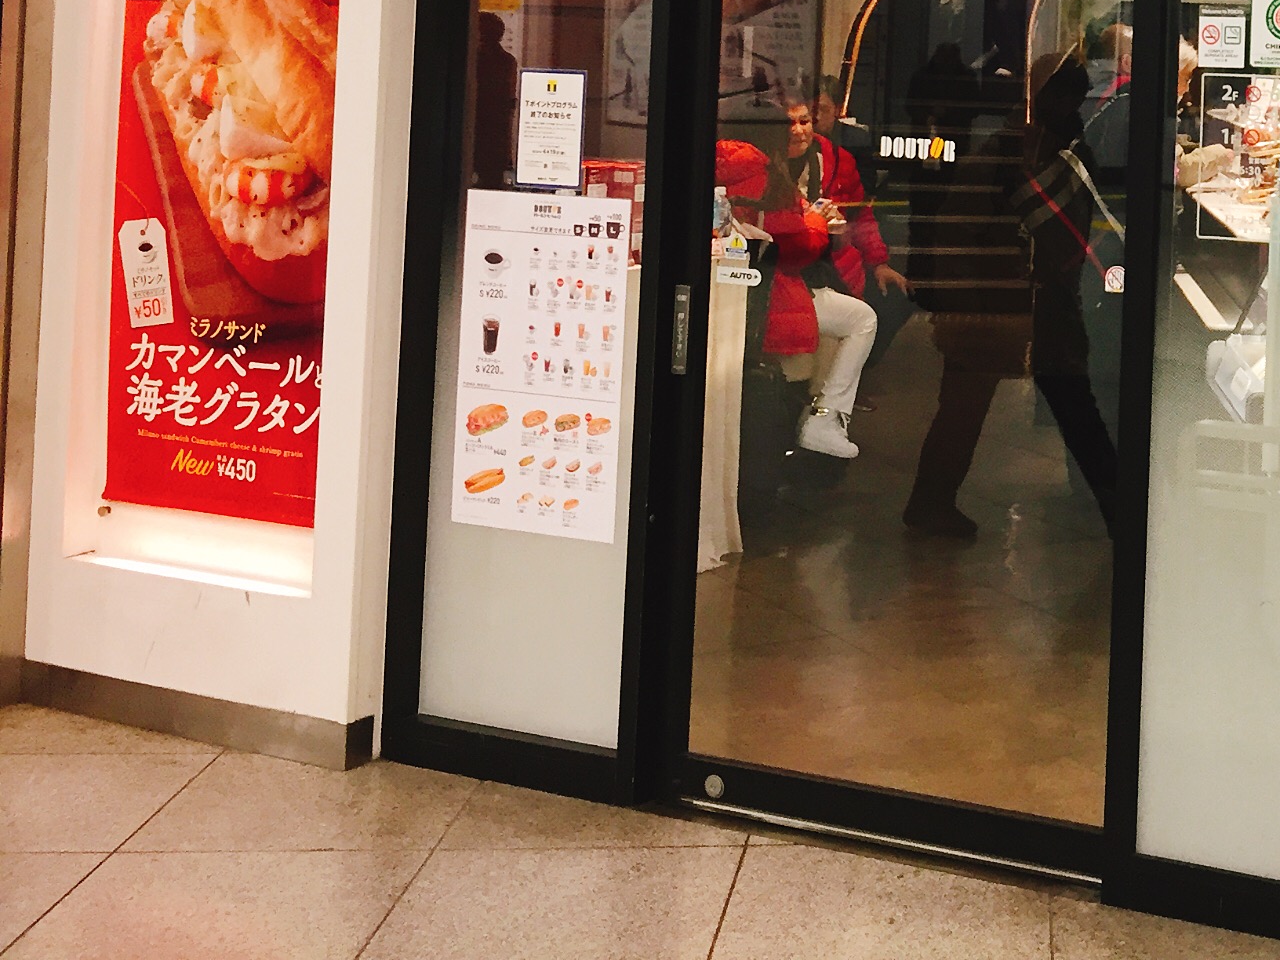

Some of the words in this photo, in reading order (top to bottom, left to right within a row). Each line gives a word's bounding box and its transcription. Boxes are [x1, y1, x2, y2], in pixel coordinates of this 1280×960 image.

[1221, 84, 1240, 102] 2F
[525, 100, 578, 109] Tポイントプログラム
[880, 136, 956, 163] DOUTOR
[609, 226, 617, 234] L
[729, 271, 753, 281] AUTO
[134, 298, 161, 319] ¥50
[189, 316, 267, 344] ミラノサンド
[126, 372, 321, 435] 海老グラタン
[170, 448, 215, 476] New
[217, 457, 256, 482] ¥450
